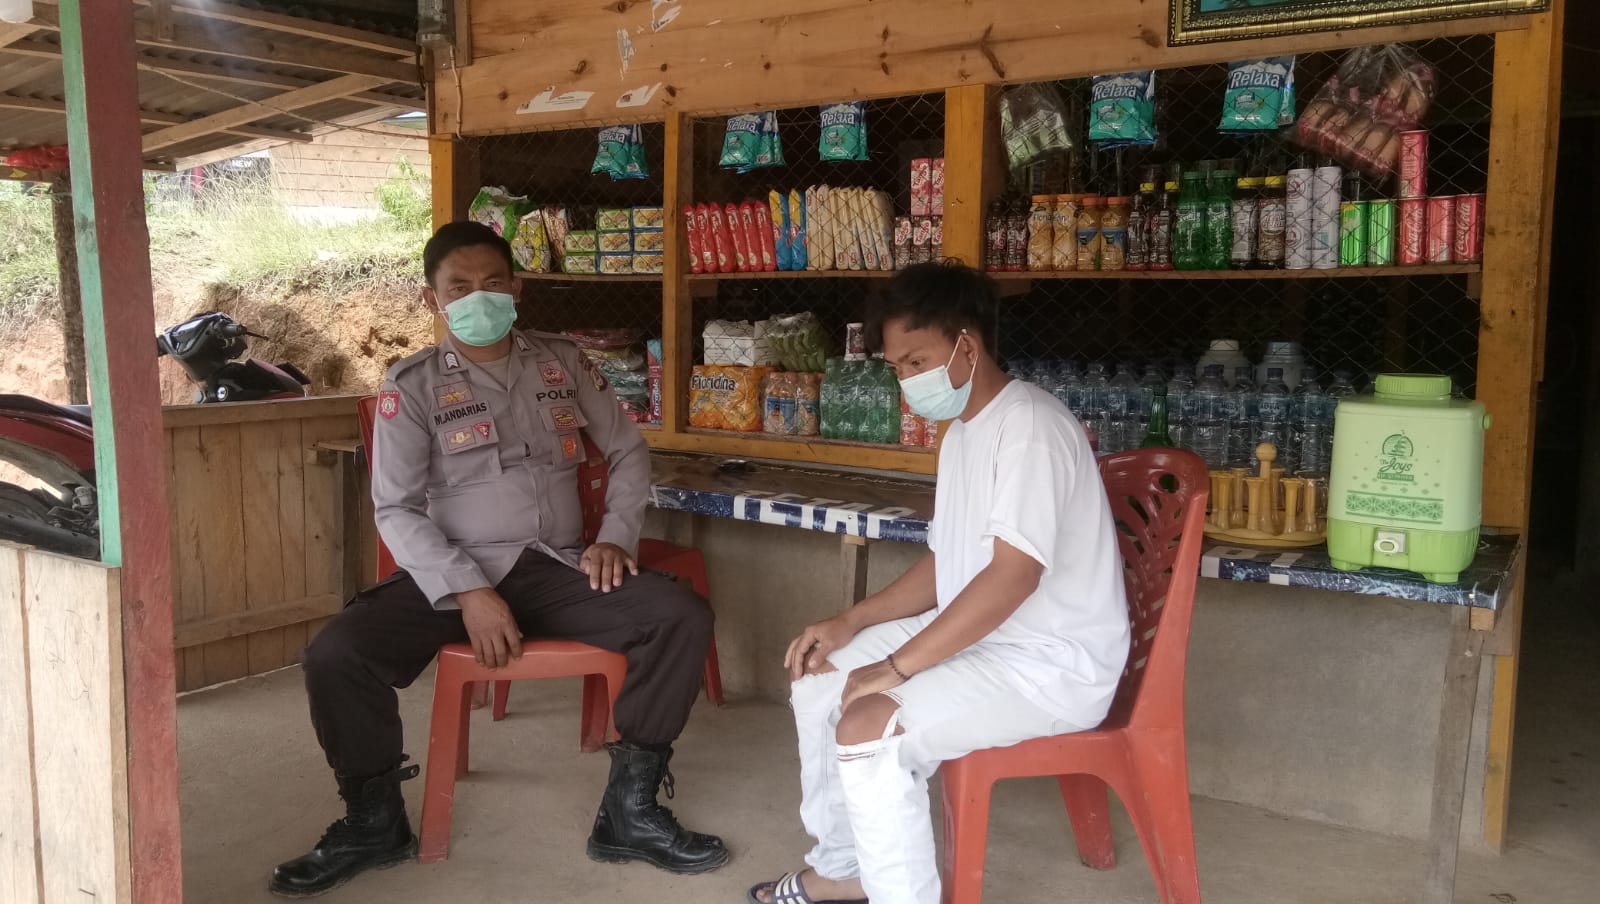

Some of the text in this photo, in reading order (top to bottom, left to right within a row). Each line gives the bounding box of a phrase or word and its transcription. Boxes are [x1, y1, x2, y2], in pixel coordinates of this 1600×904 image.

[1229, 69, 1281, 89] Relaxa
[1093, 84, 1137, 101] Relaxa
[821, 111, 855, 128] Relaxa
[231, 159, 252, 168] NEW
[690, 374, 736, 391] Floridina
[536, 389, 576, 402] POLRI
[1378, 456, 1413, 474] Joys
